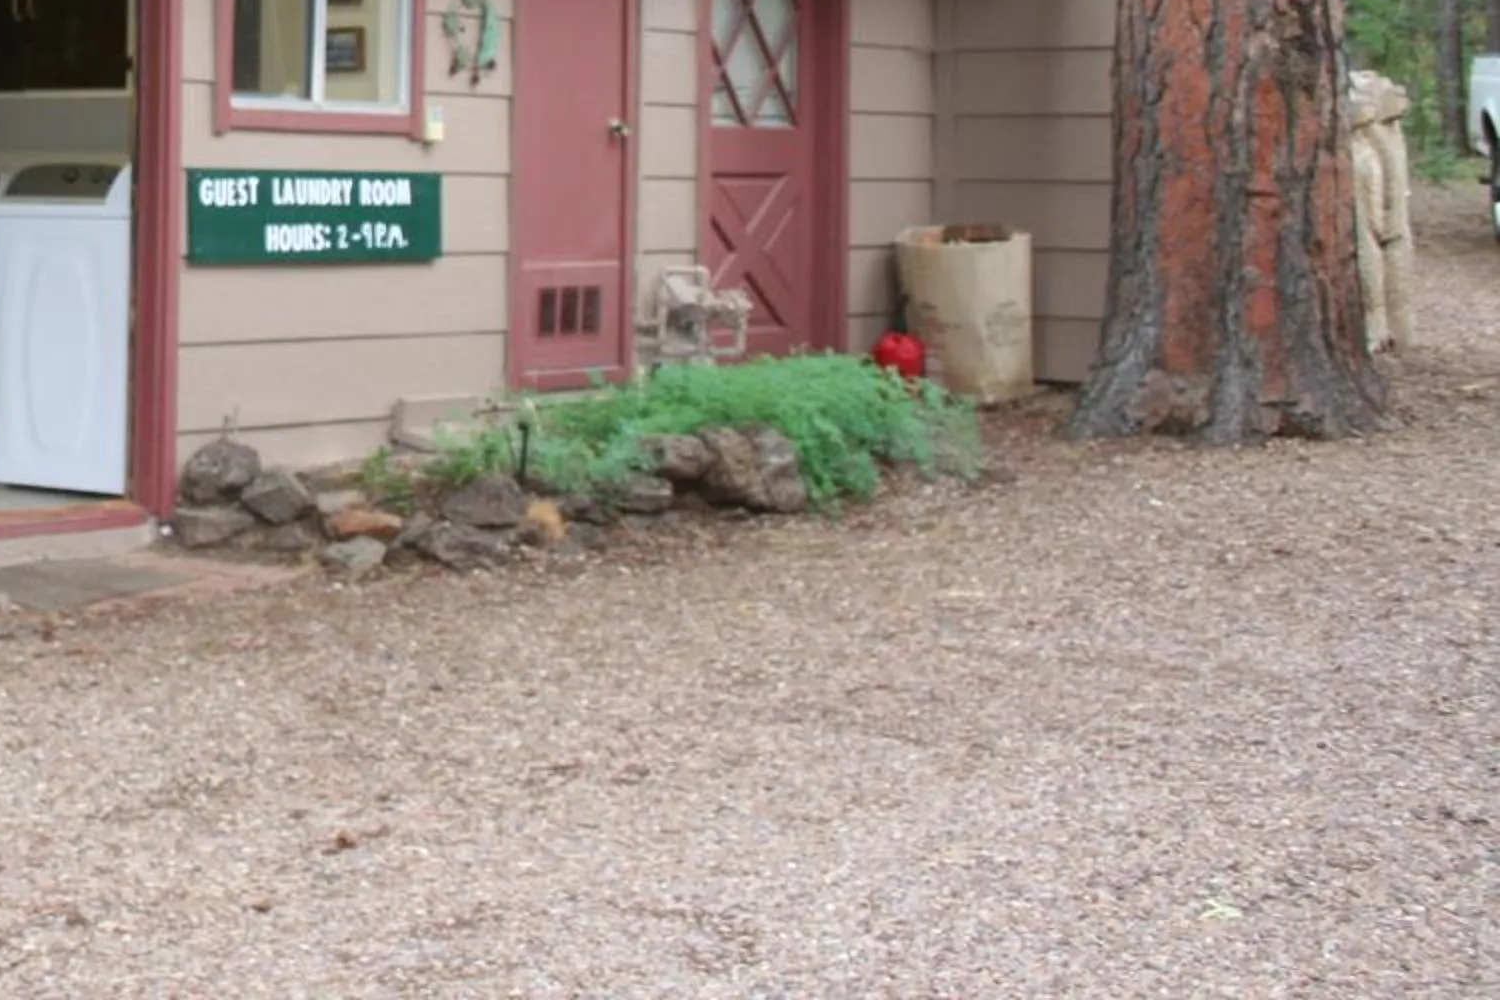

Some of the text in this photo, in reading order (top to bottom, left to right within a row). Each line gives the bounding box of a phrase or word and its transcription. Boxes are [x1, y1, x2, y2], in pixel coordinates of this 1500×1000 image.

[199, 176, 412, 207] GUEST LAUNDRY ROOM
[265, 223, 332, 253] HOURS:
